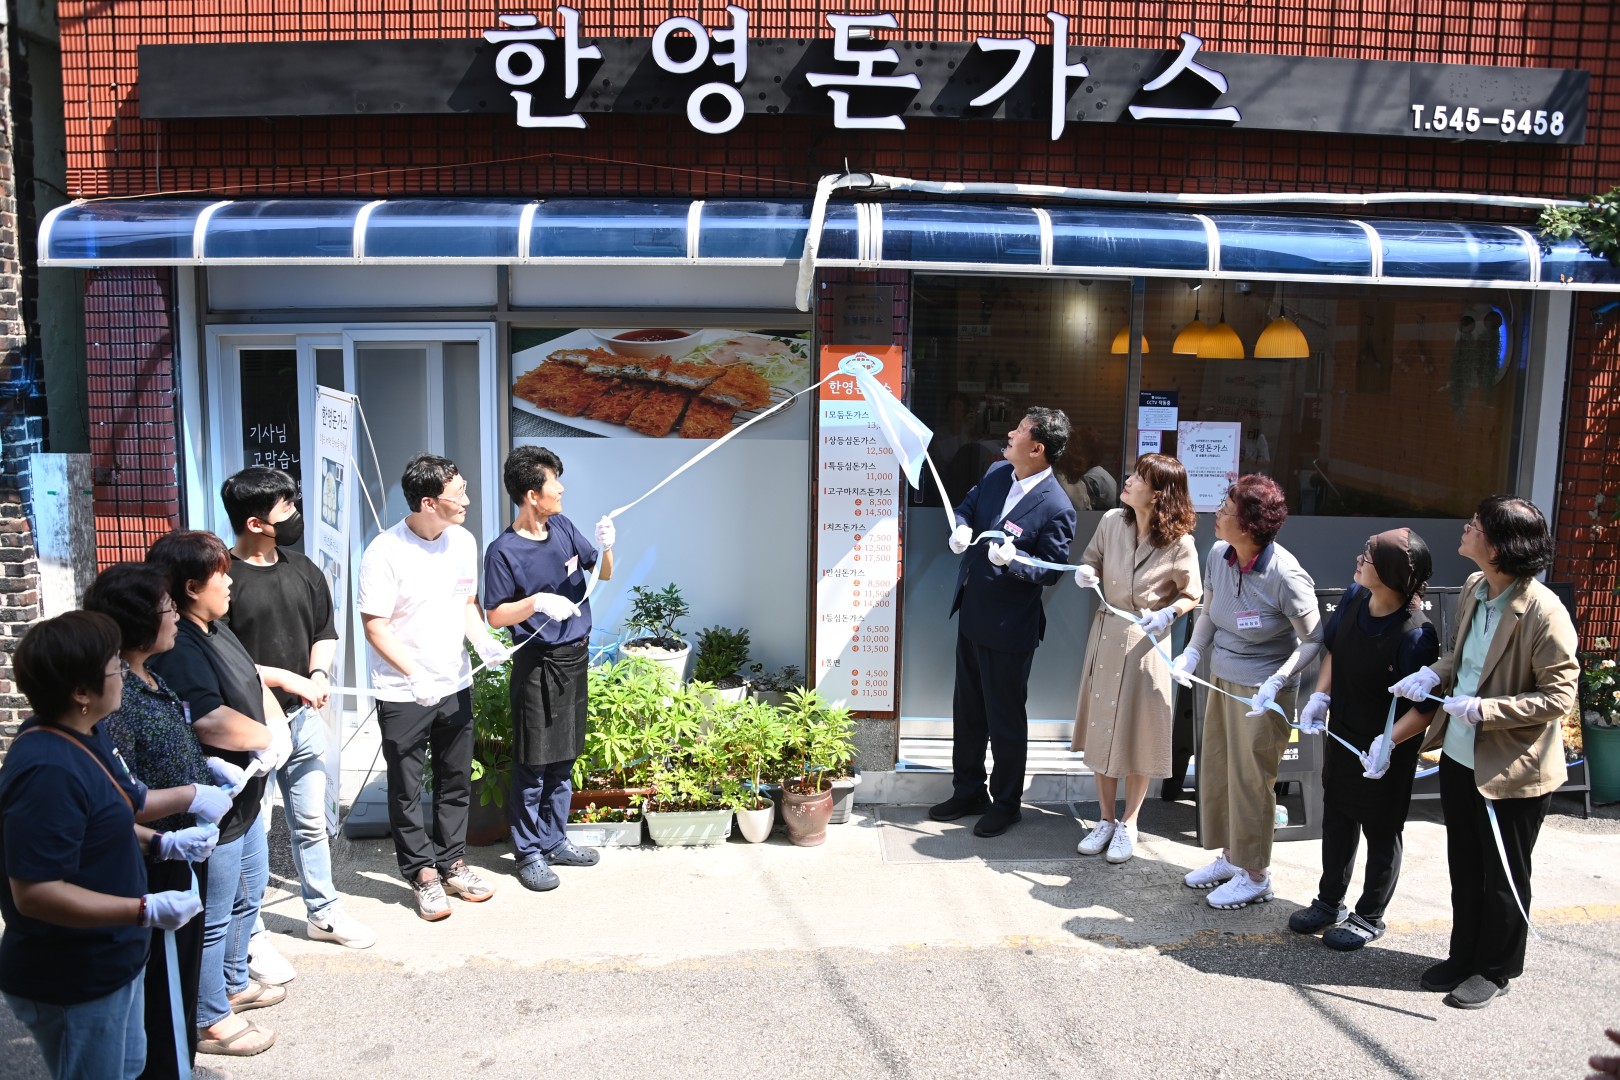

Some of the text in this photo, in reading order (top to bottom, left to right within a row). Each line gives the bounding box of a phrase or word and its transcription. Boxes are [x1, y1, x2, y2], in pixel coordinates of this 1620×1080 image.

[483, 4, 1242, 141] 한영돈가스
[1412, 104, 1565, 136] T.545-5458
[321, 405, 348, 431] 한영돈가스
[250, 423, 287, 444] 기사님
[828, 436, 877, 446] 상등심돈가스
[866, 447, 894, 456] 12,500
[1190, 443, 1229, 453] 한영돈가스
[828, 461, 877, 471] 특등심돈가스
[866, 472, 893, 481] 11,000
[827, 487, 892, 497] 고구마치즈돈가스
[869, 498, 893, 507] 8,500
[865, 508, 892, 517] 14,500
[827, 522, 867, 532] 치즈돈가스
[869, 534, 892, 543] 7,500
[864, 544, 891, 553] 12,500
[864, 554, 891, 563] 17,500
[826, 568, 866, 578] 안심돈가스
[867, 580, 891, 589] 8,500
[865, 590, 890, 599] 11,500
[864, 600, 890, 609] 14,500
[826, 613, 866, 623] 등심돈가스
[866, 625, 890, 633] 6,500
[862, 635, 889, 643] 10,000
[862, 645, 889, 653] 13,500
[865, 669, 888, 678] 4,500
[865, 679, 888, 687] 8,000
[862, 689, 888, 697] 11,500
